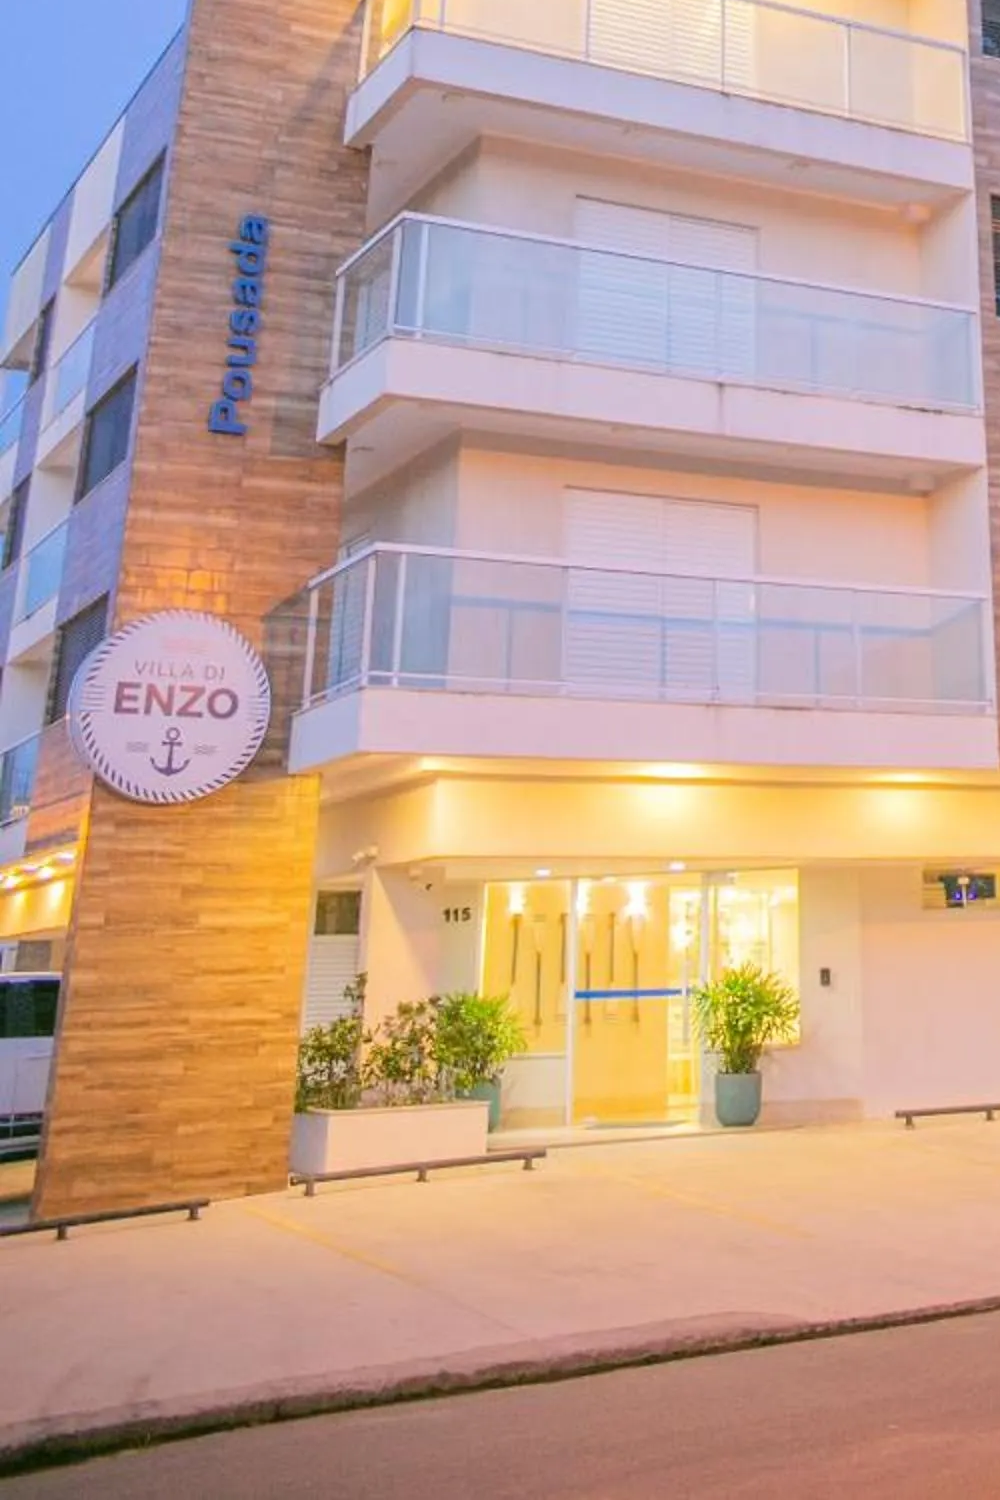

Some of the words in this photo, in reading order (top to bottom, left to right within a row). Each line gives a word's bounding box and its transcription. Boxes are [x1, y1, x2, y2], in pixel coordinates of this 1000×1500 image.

[208, 213, 269, 436] Pousada
[134, 659, 195, 680] VILLA
[204, 664, 226, 681] DI
[113, 681, 239, 720] ENZO
[442, 907, 472, 924] 115
